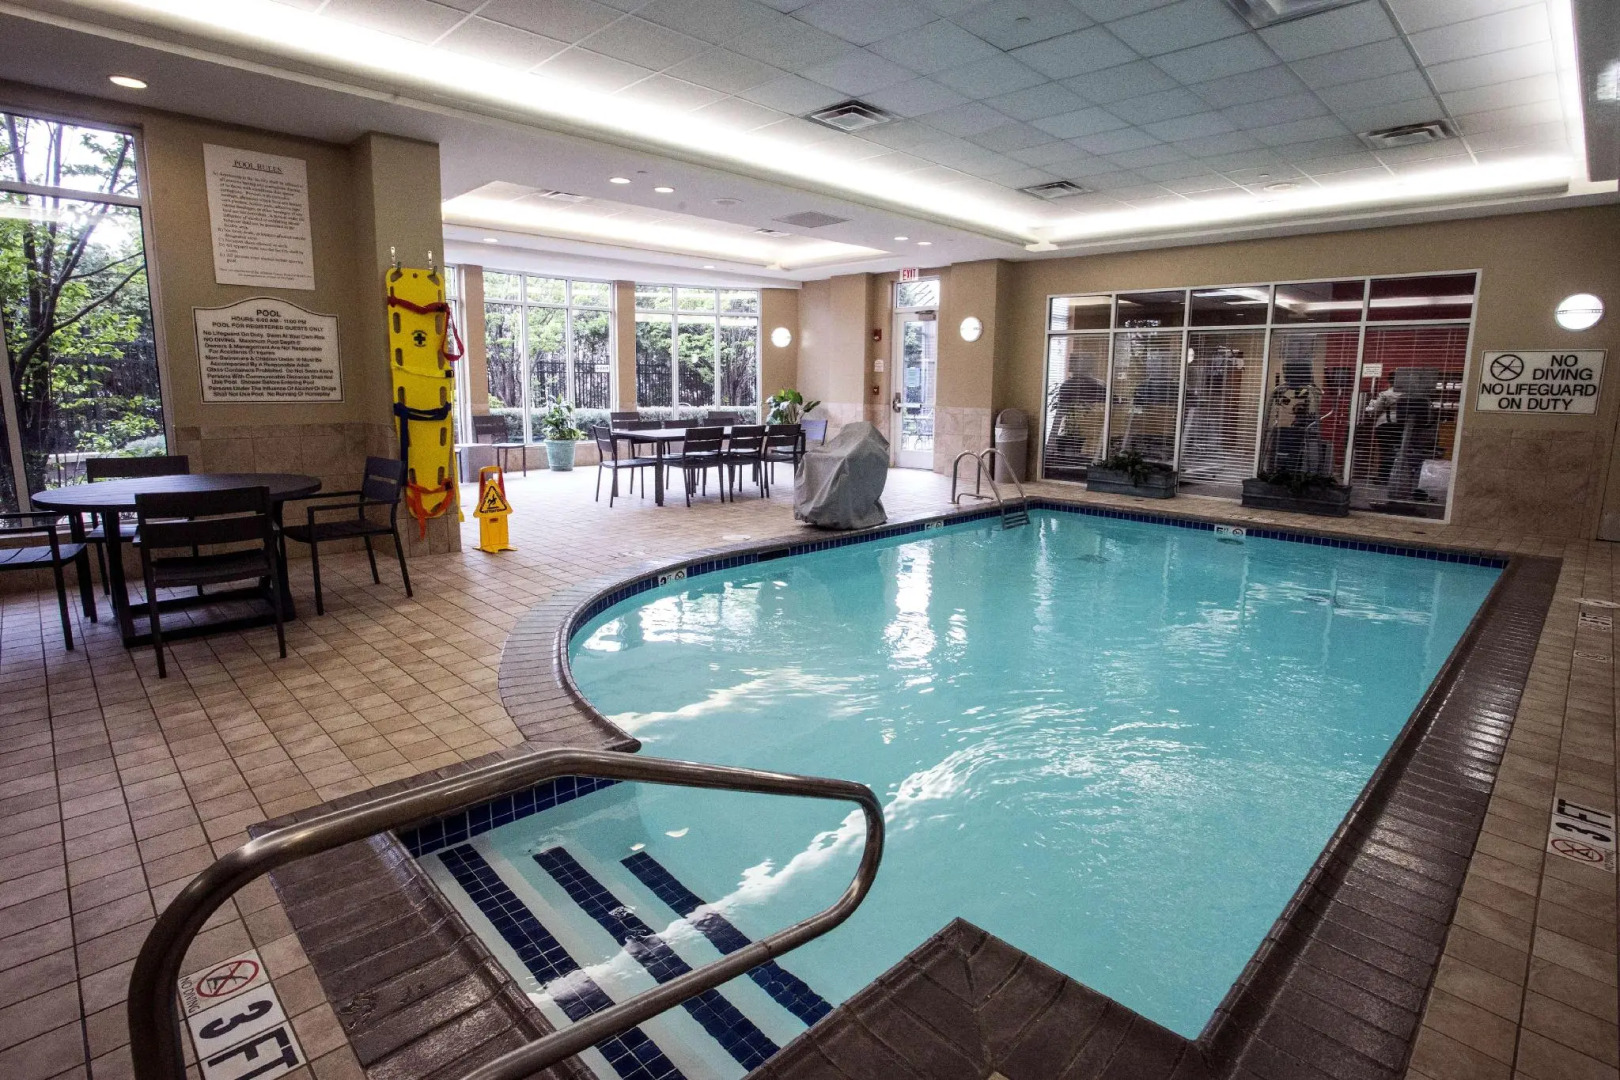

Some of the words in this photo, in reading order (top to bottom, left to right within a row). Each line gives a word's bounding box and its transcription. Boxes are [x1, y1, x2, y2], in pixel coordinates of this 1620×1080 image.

[234, 160, 253, 169] POOL
[903, 268, 916, 280] EXIT
[1550, 354, 1578, 367] NO
[1532, 368, 1593, 380] DIVING
[1481, 383, 1504, 395] NO
[1506, 384, 1597, 396] LIFEGUARD
[1498, 398, 1522, 410] ON
[1527, 398, 1574, 410] DUTY
[1556, 798, 1612, 829] FT
[1555, 822, 1612, 842] 3
[180, 976, 193, 990] NO
[183, 986, 202, 1014] DIVING
[199, 1000, 274, 1040] 3
[207, 1026, 300, 1080] FT
